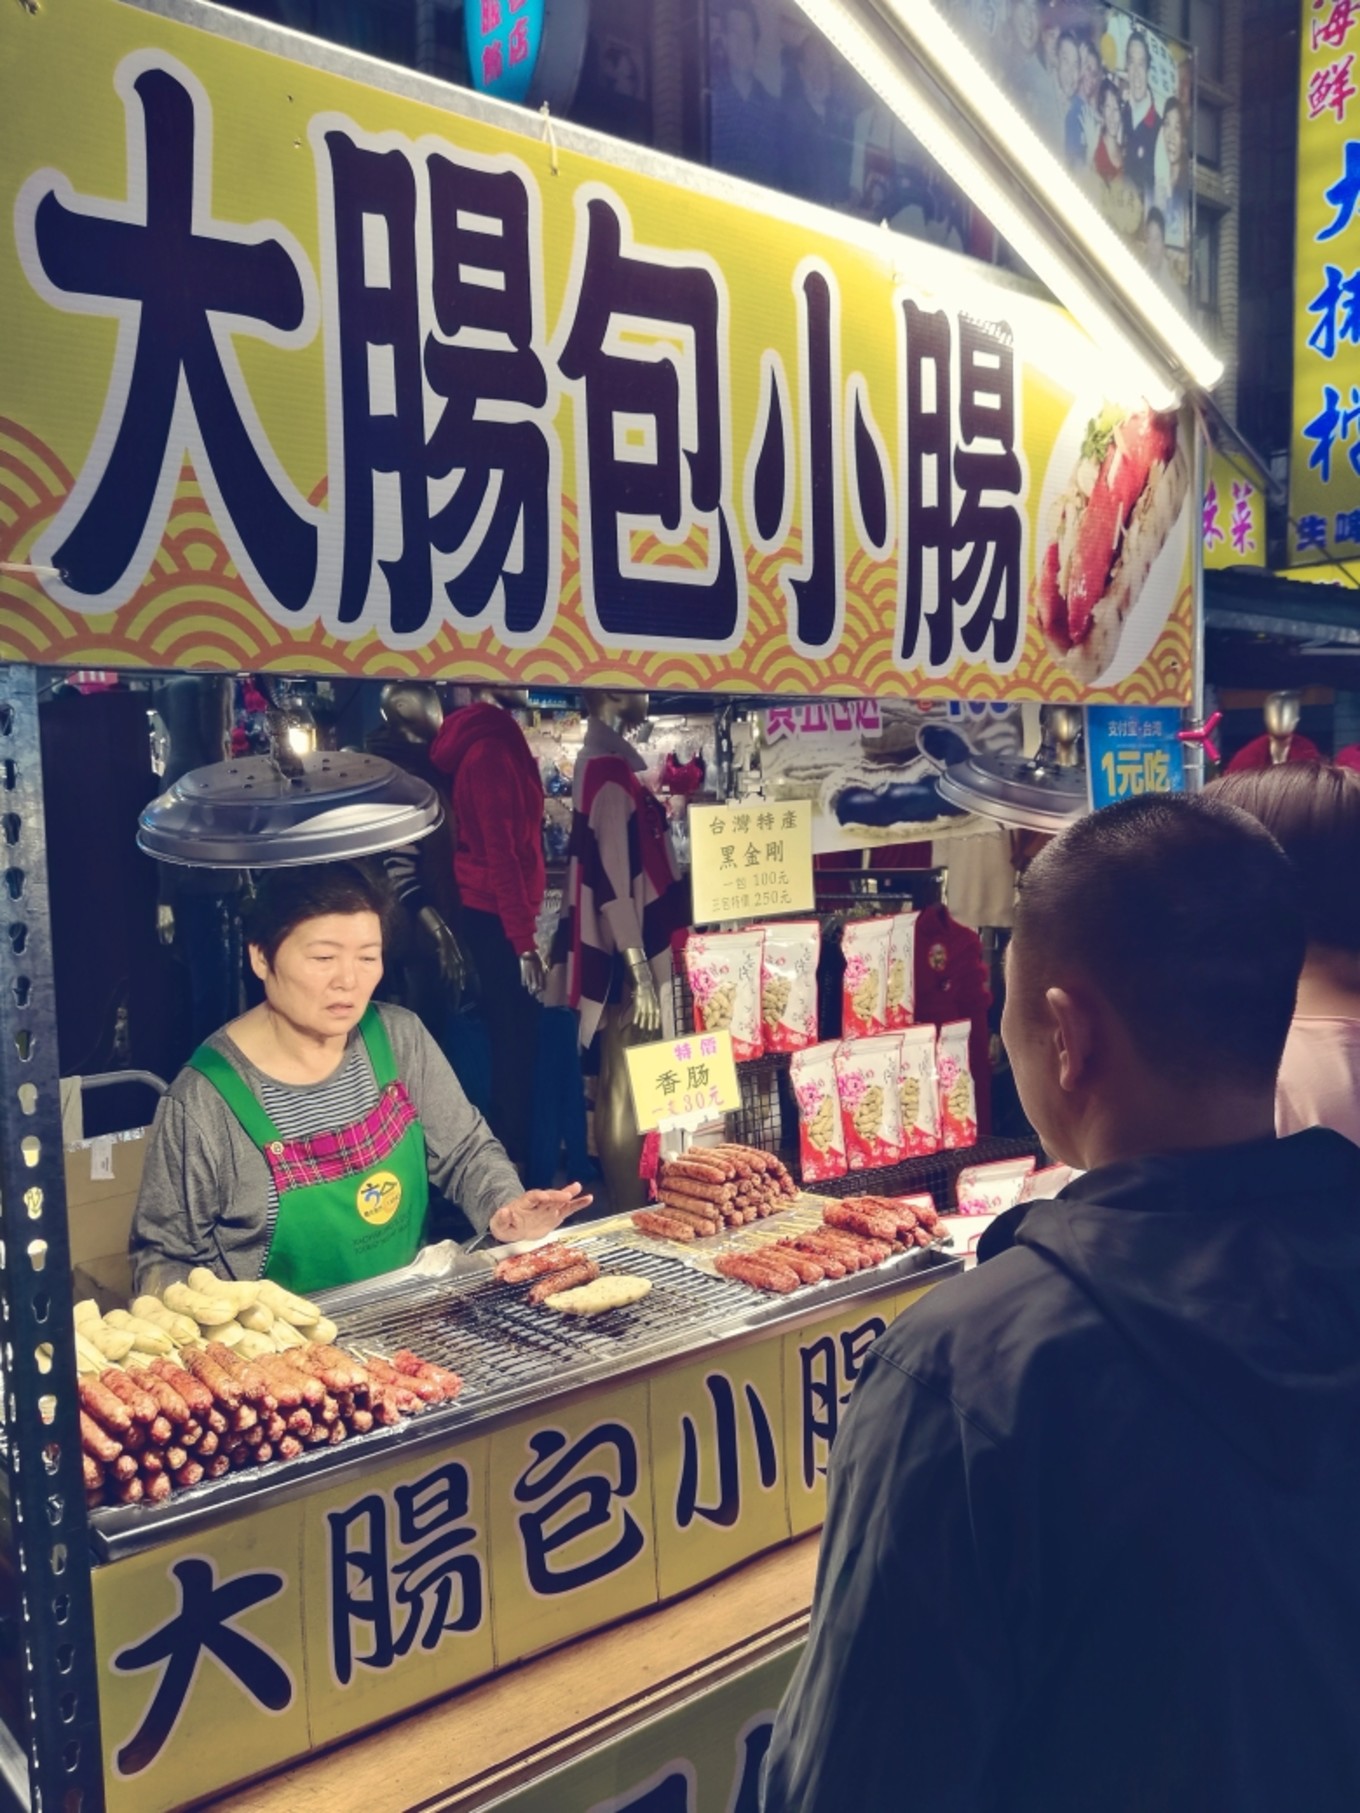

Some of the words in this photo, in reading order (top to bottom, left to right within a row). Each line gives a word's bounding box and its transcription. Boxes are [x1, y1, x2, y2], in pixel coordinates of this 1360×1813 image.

[1308, 0, 1356, 121] 海鮮
[35, 68, 1023, 666] 大腸包小腸
[1101, 750, 1171, 797] 1元吃
[709, 810, 797, 836] 台灣特產
[719, 840, 784, 871] 黑金剛
[655, 1063, 709, 1096] 香肠
